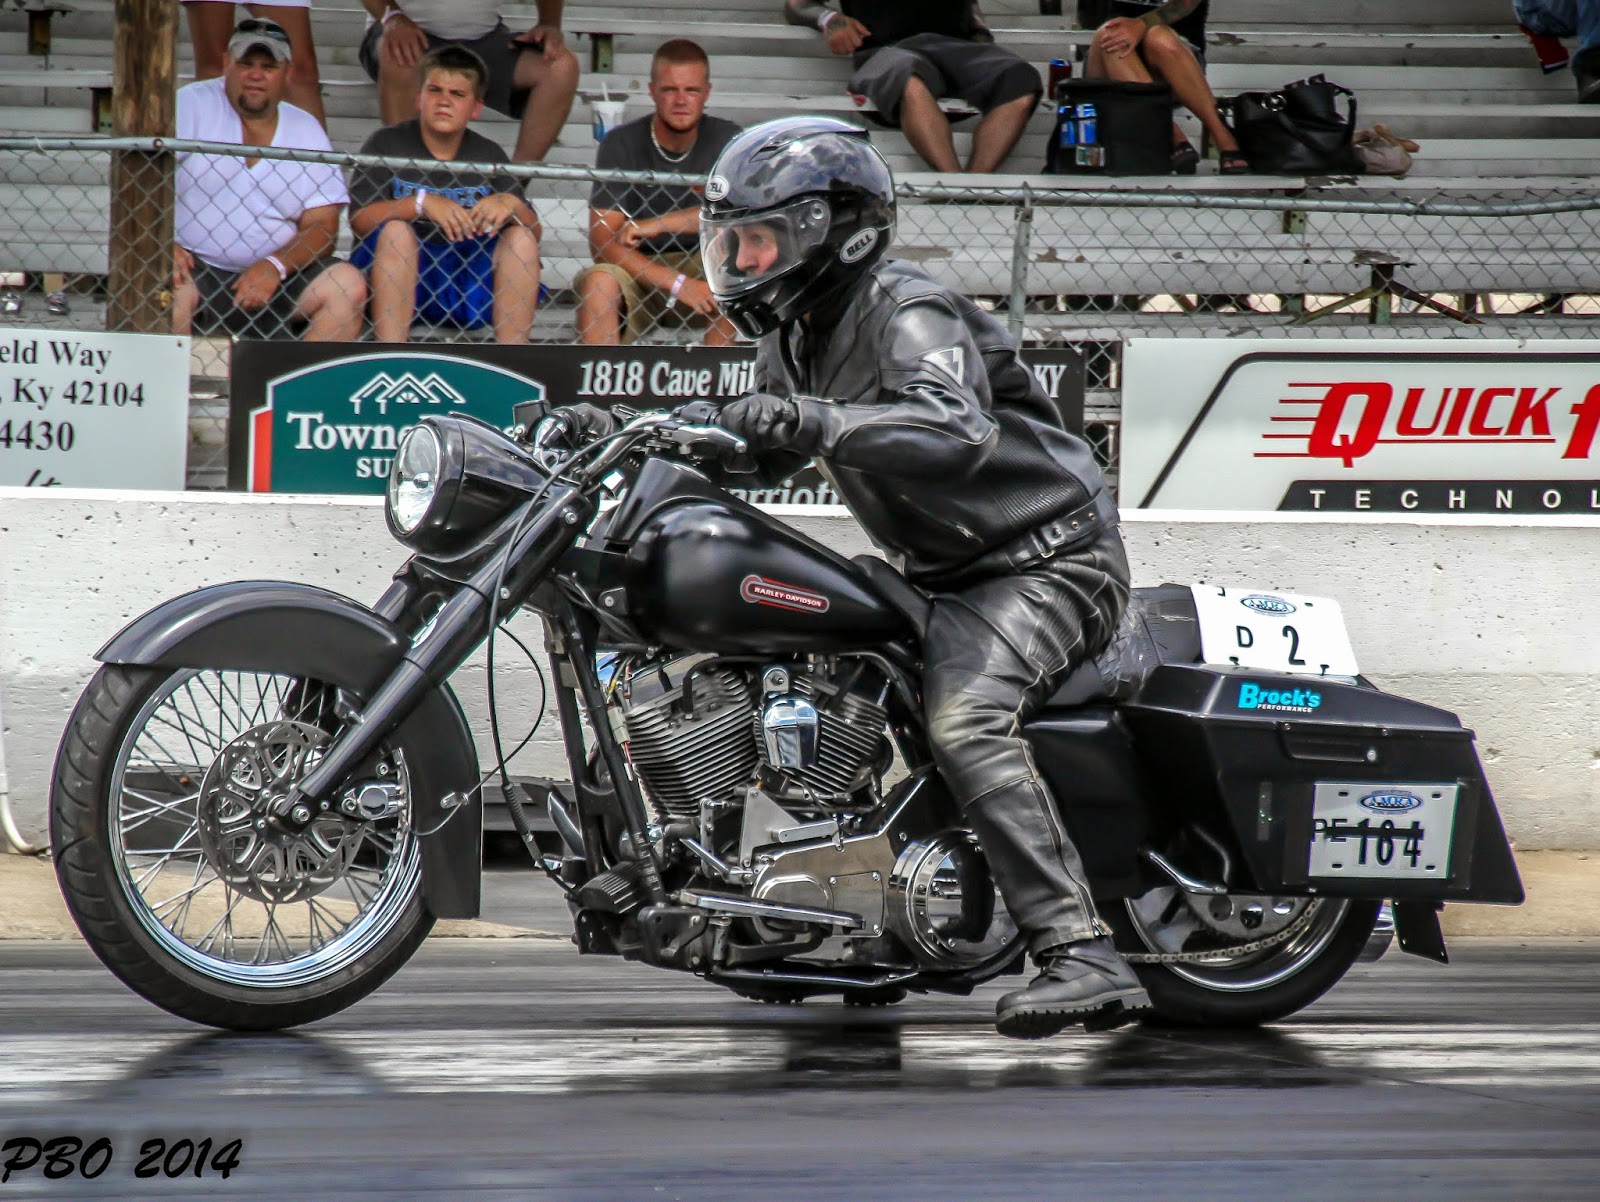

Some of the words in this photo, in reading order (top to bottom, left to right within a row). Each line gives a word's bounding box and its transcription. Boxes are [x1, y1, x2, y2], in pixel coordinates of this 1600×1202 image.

[846, 233, 873, 258] BELL
[49, 341, 112, 374] Way
[12, 378, 54, 411] Ky
[62, 380, 145, 407] 42104
[576, 360, 645, 396] 1818
[650, 361, 712, 397] Cave
[1308, 382, 1563, 468] QUICK
[1236, 625, 1254, 648] D
[1282, 625, 1306, 666] 2
[1238, 682, 1322, 709] Brock's
[1257, 703, 1313, 713] PERFORMANCE
